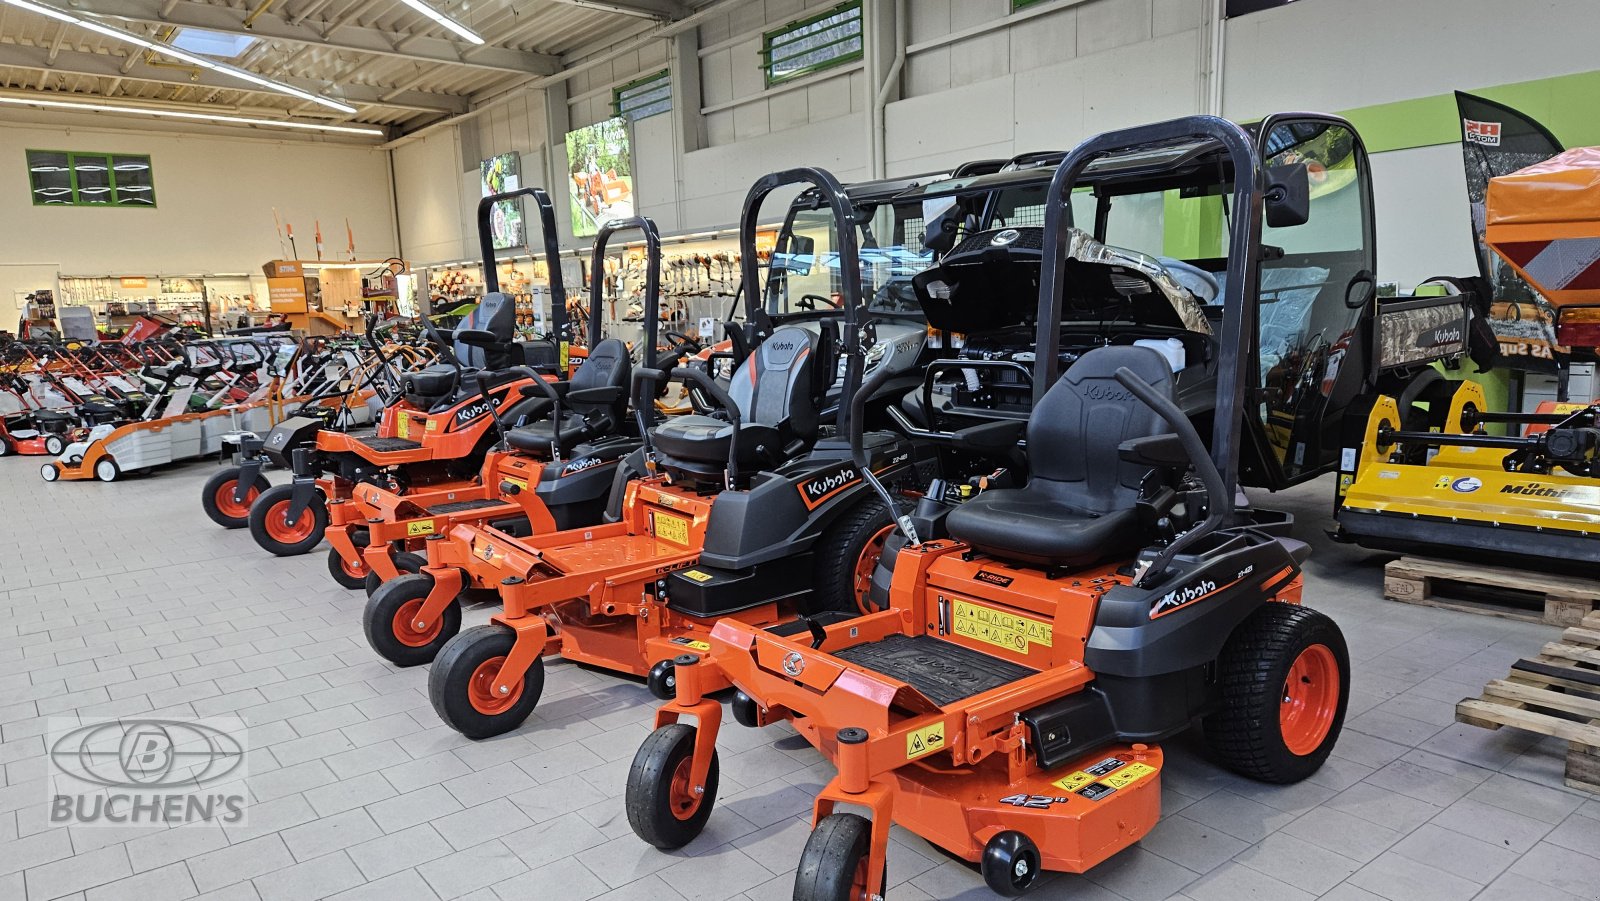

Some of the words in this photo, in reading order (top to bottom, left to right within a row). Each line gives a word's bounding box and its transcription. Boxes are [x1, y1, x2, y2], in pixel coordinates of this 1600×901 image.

[1434, 327, 1460, 344] Kubota
[772, 341, 794, 352] Kubota
[569, 357, 586, 365] ZD
[457, 398, 501, 420] Kuboa
[566, 457, 602, 471] Kubota
[807, 469, 855, 495] Kubota
[978, 572, 1011, 584] K-RIDE
[1160, 580, 1216, 606] Kubota
[999, 793, 1054, 809] 42
